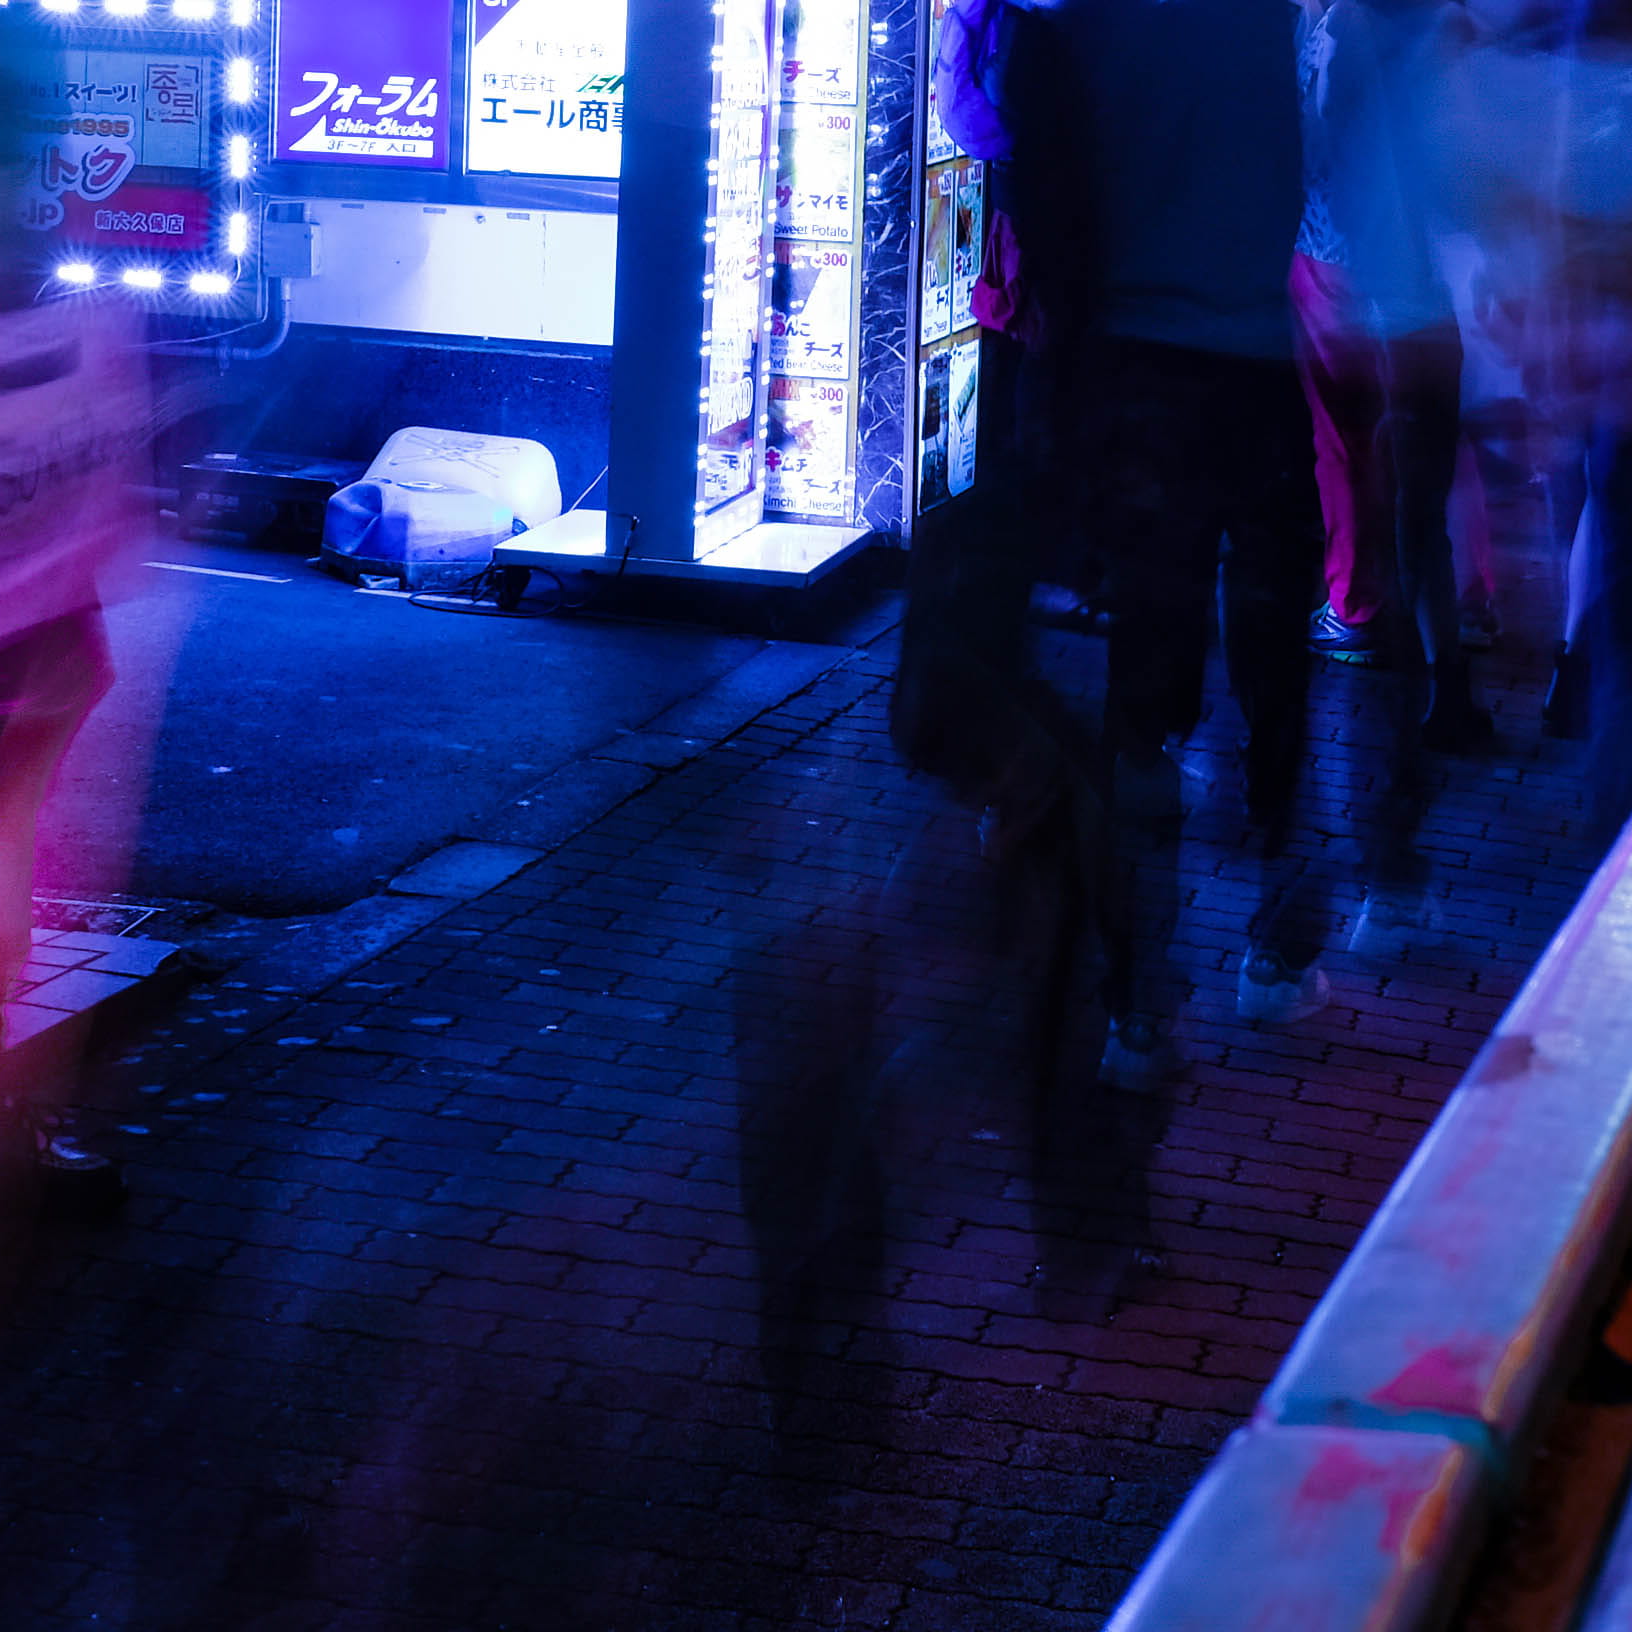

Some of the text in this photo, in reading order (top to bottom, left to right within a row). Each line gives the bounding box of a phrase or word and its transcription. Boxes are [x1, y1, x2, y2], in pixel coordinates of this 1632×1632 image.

[290, 71, 439, 118] フォーラム
